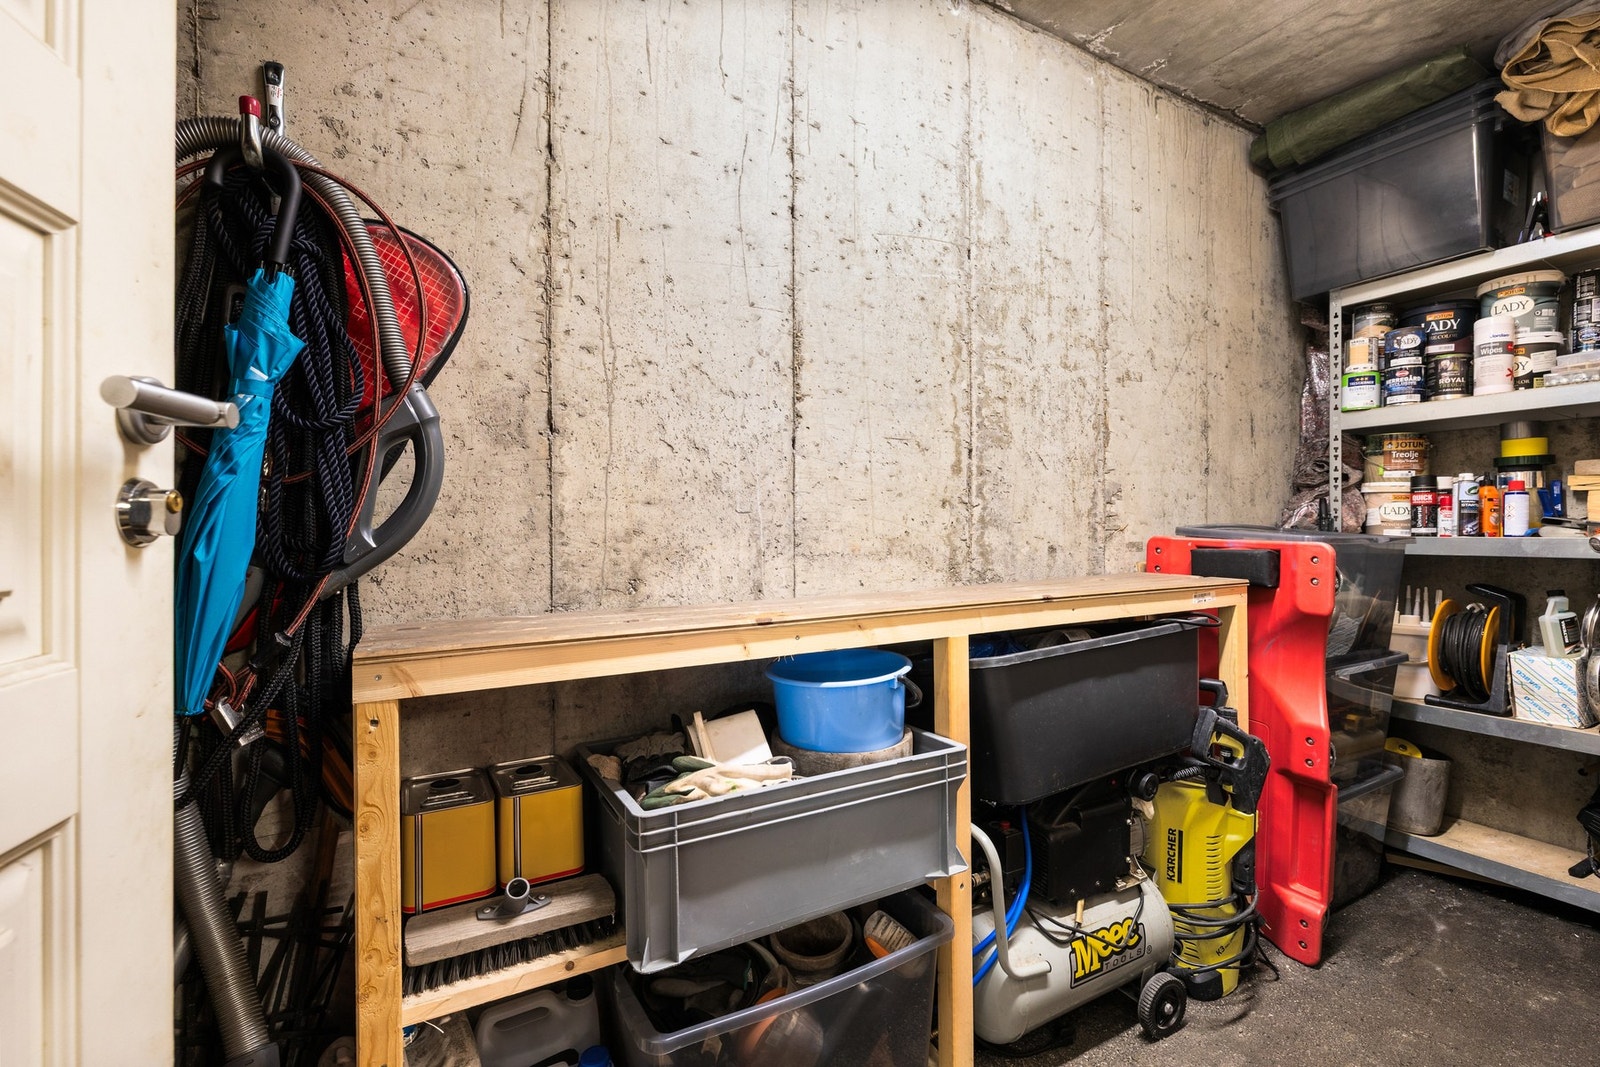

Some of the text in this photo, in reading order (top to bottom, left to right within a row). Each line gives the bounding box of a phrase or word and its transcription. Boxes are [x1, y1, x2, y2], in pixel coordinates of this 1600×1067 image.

[1494, 300, 1528, 315] LADY
[1480, 347, 1503, 355] Wipes
[1514, 361, 1528, 371] DY
[1395, 441, 1424, 449] JOTUN
[1391, 451, 1419, 460] Treolje
[1516, 669, 1541, 691] WABCO
[1167, 828, 1176, 882] KÄRCHER
[1071, 917, 1140, 979] Meec
[1215, 945, 1226, 957] K3
[1105, 948, 1142, 969] TOOLS
